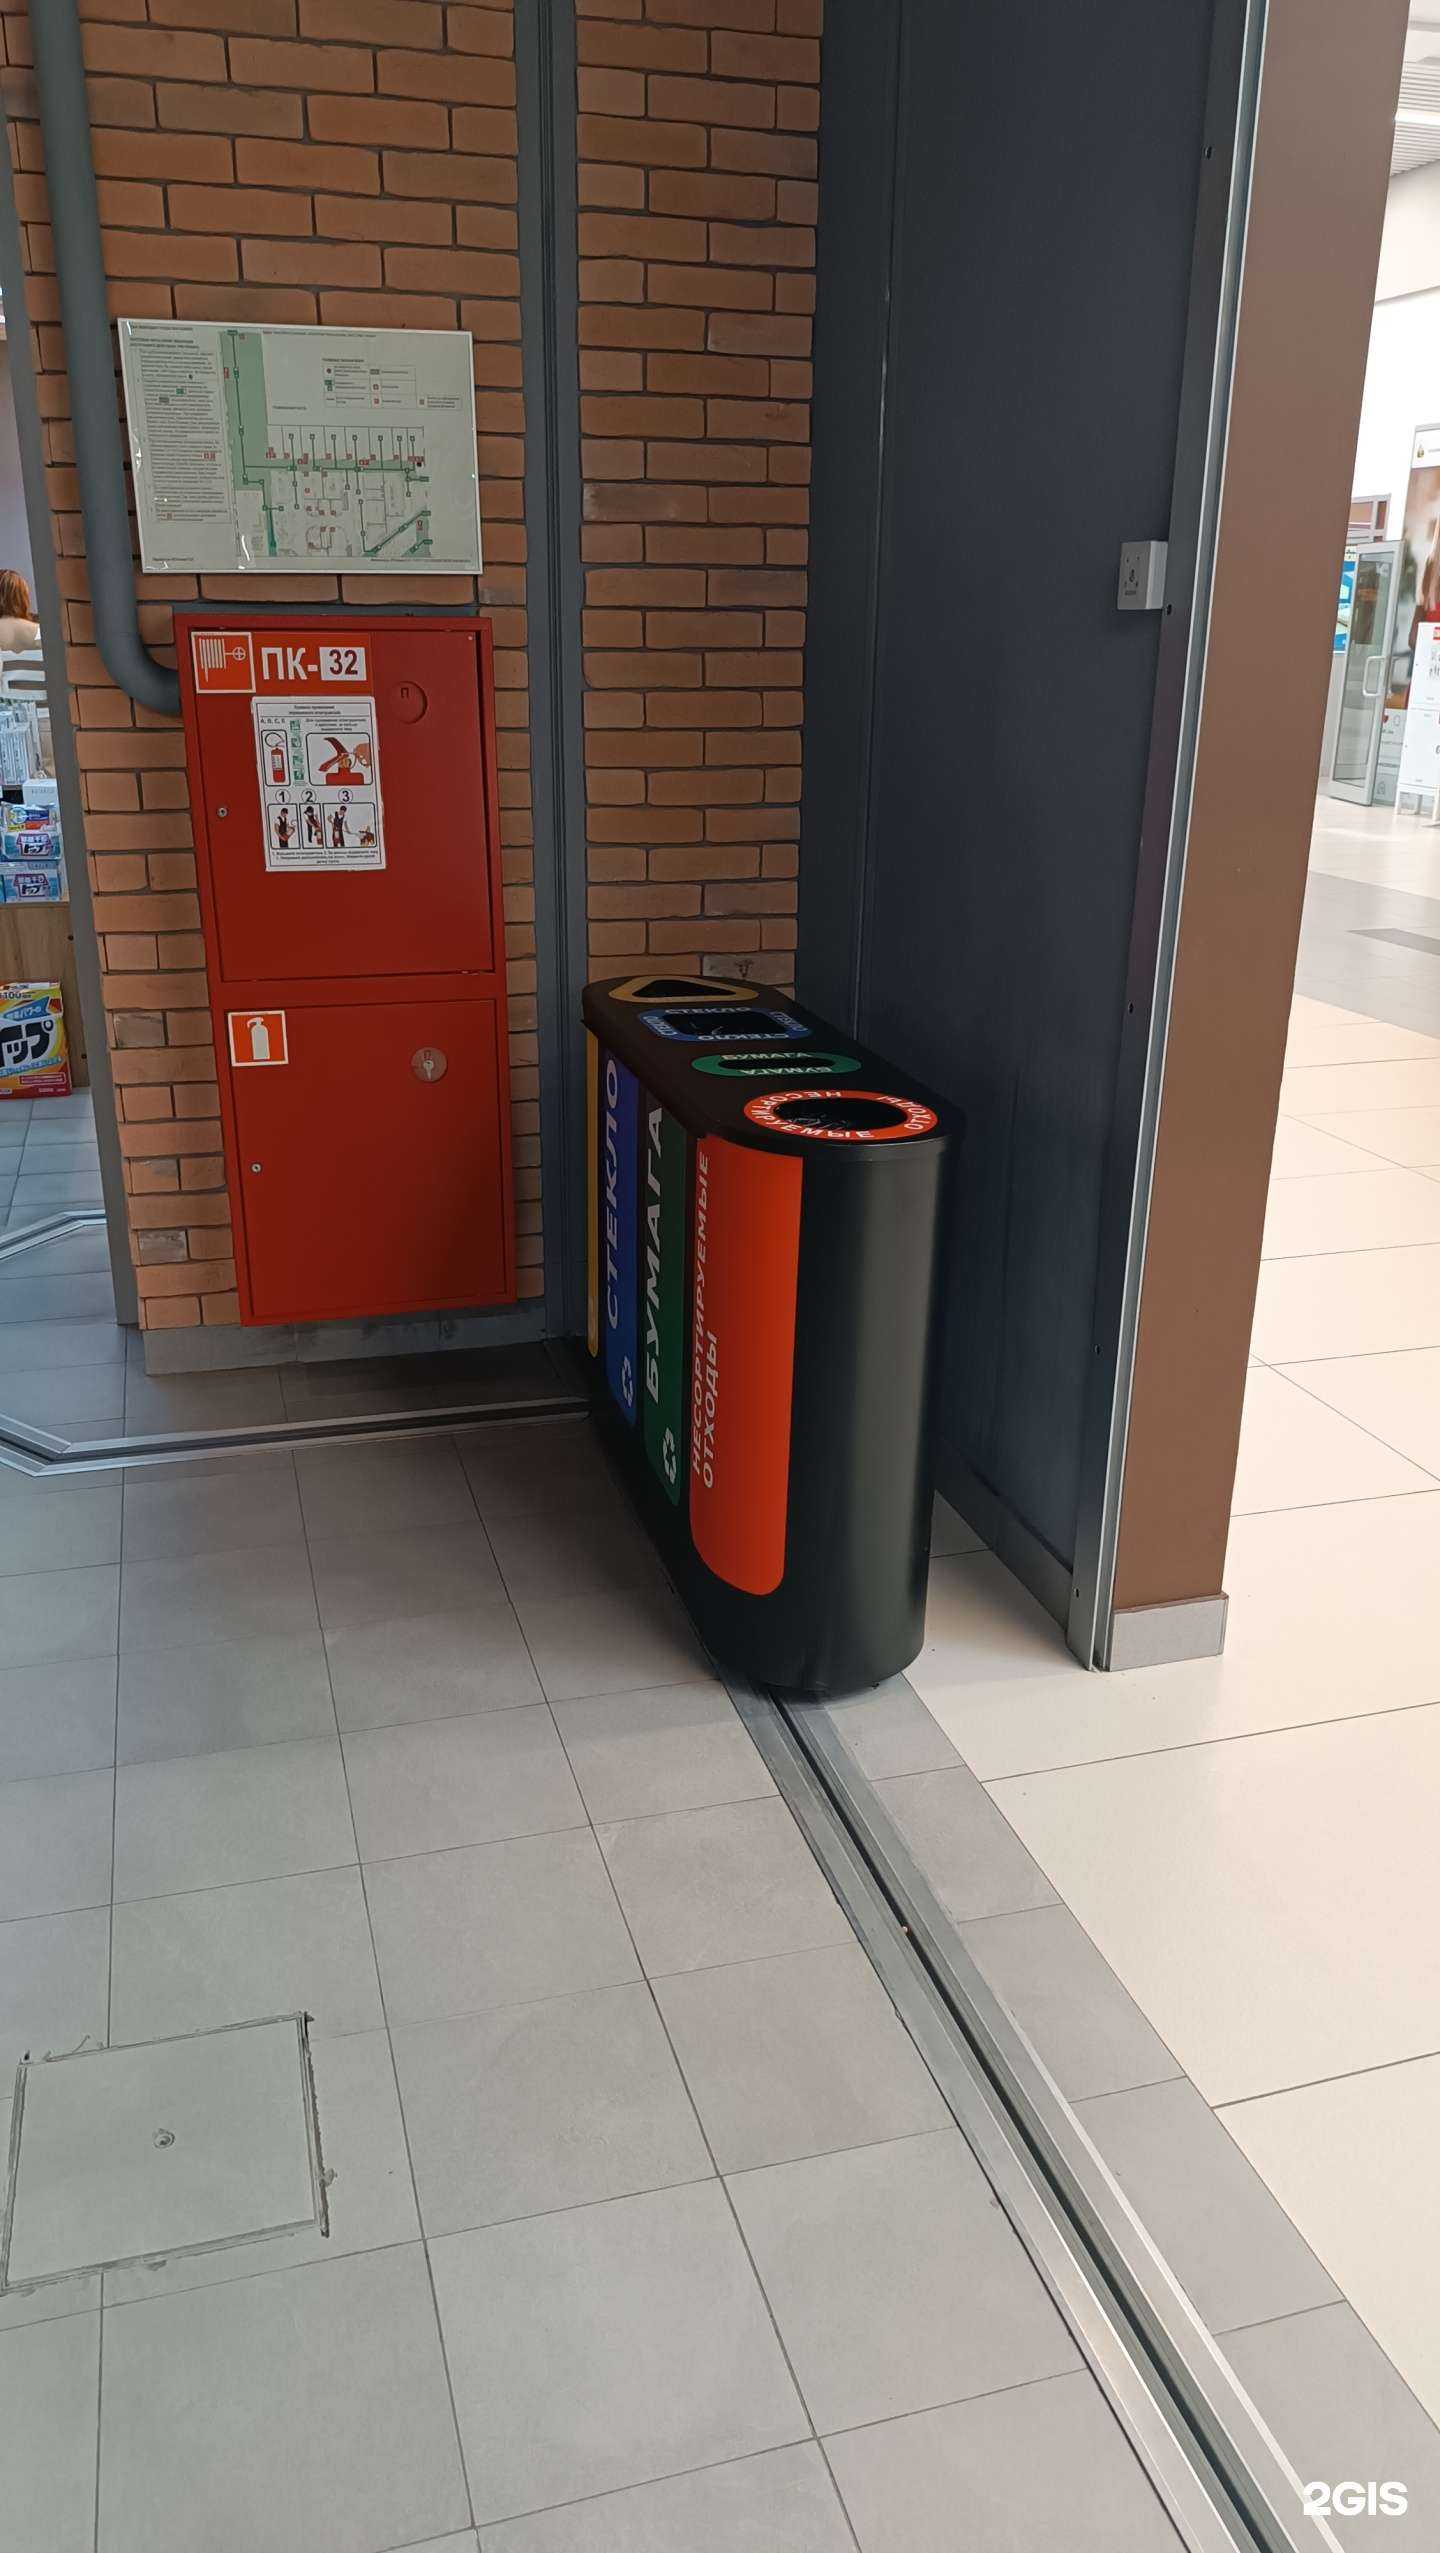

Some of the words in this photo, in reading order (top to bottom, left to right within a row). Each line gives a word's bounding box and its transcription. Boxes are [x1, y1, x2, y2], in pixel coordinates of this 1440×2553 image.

[720, 1051, 812, 1060] БУМАГА
[741, 1065, 833, 1075] БУМАГА
[751, 1090, 876, 1138] НЕСОРТИРУЕМЫЕ
[606, 1059, 618, 1329] СТЕКЛО
[646, 1106, 662, 1404] БУМАГА
[693, 1153, 709, 1476] НЕСОРТИРУЕМЫЕ
[704, 1330, 719, 1489] ОТХОДЫ
